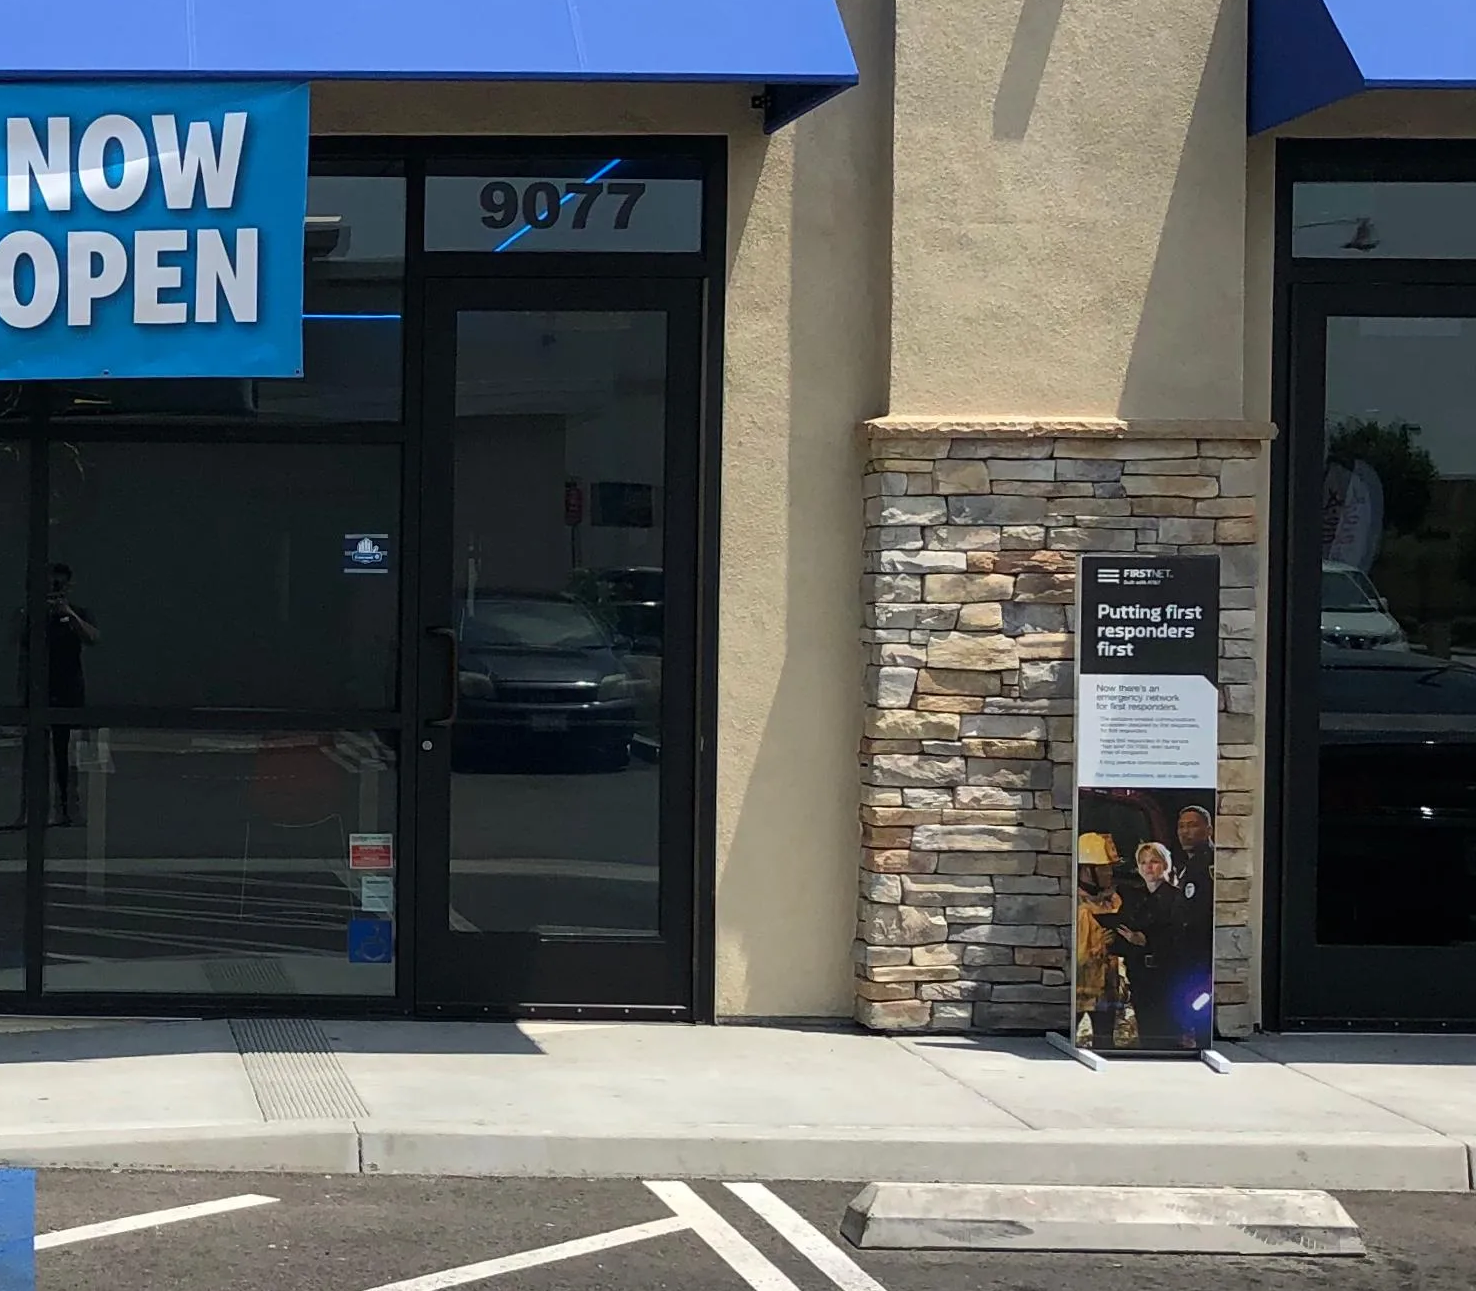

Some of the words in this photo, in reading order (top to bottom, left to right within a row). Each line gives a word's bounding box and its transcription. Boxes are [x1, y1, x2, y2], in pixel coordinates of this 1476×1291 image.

[6, 111, 248, 213] NOW
[480, 181, 646, 230] 9077
[1097, 603, 1162, 622] Putting
[1165, 604, 1203, 619] first
[1097, 623, 1195, 640] responders
[1097, 641, 1134, 656] first
[1096, 684, 1117, 692] Now
[1096, 694, 1143, 703] emergency
[1096, 702, 1108, 710] for
[1110, 702, 1126, 710] first
